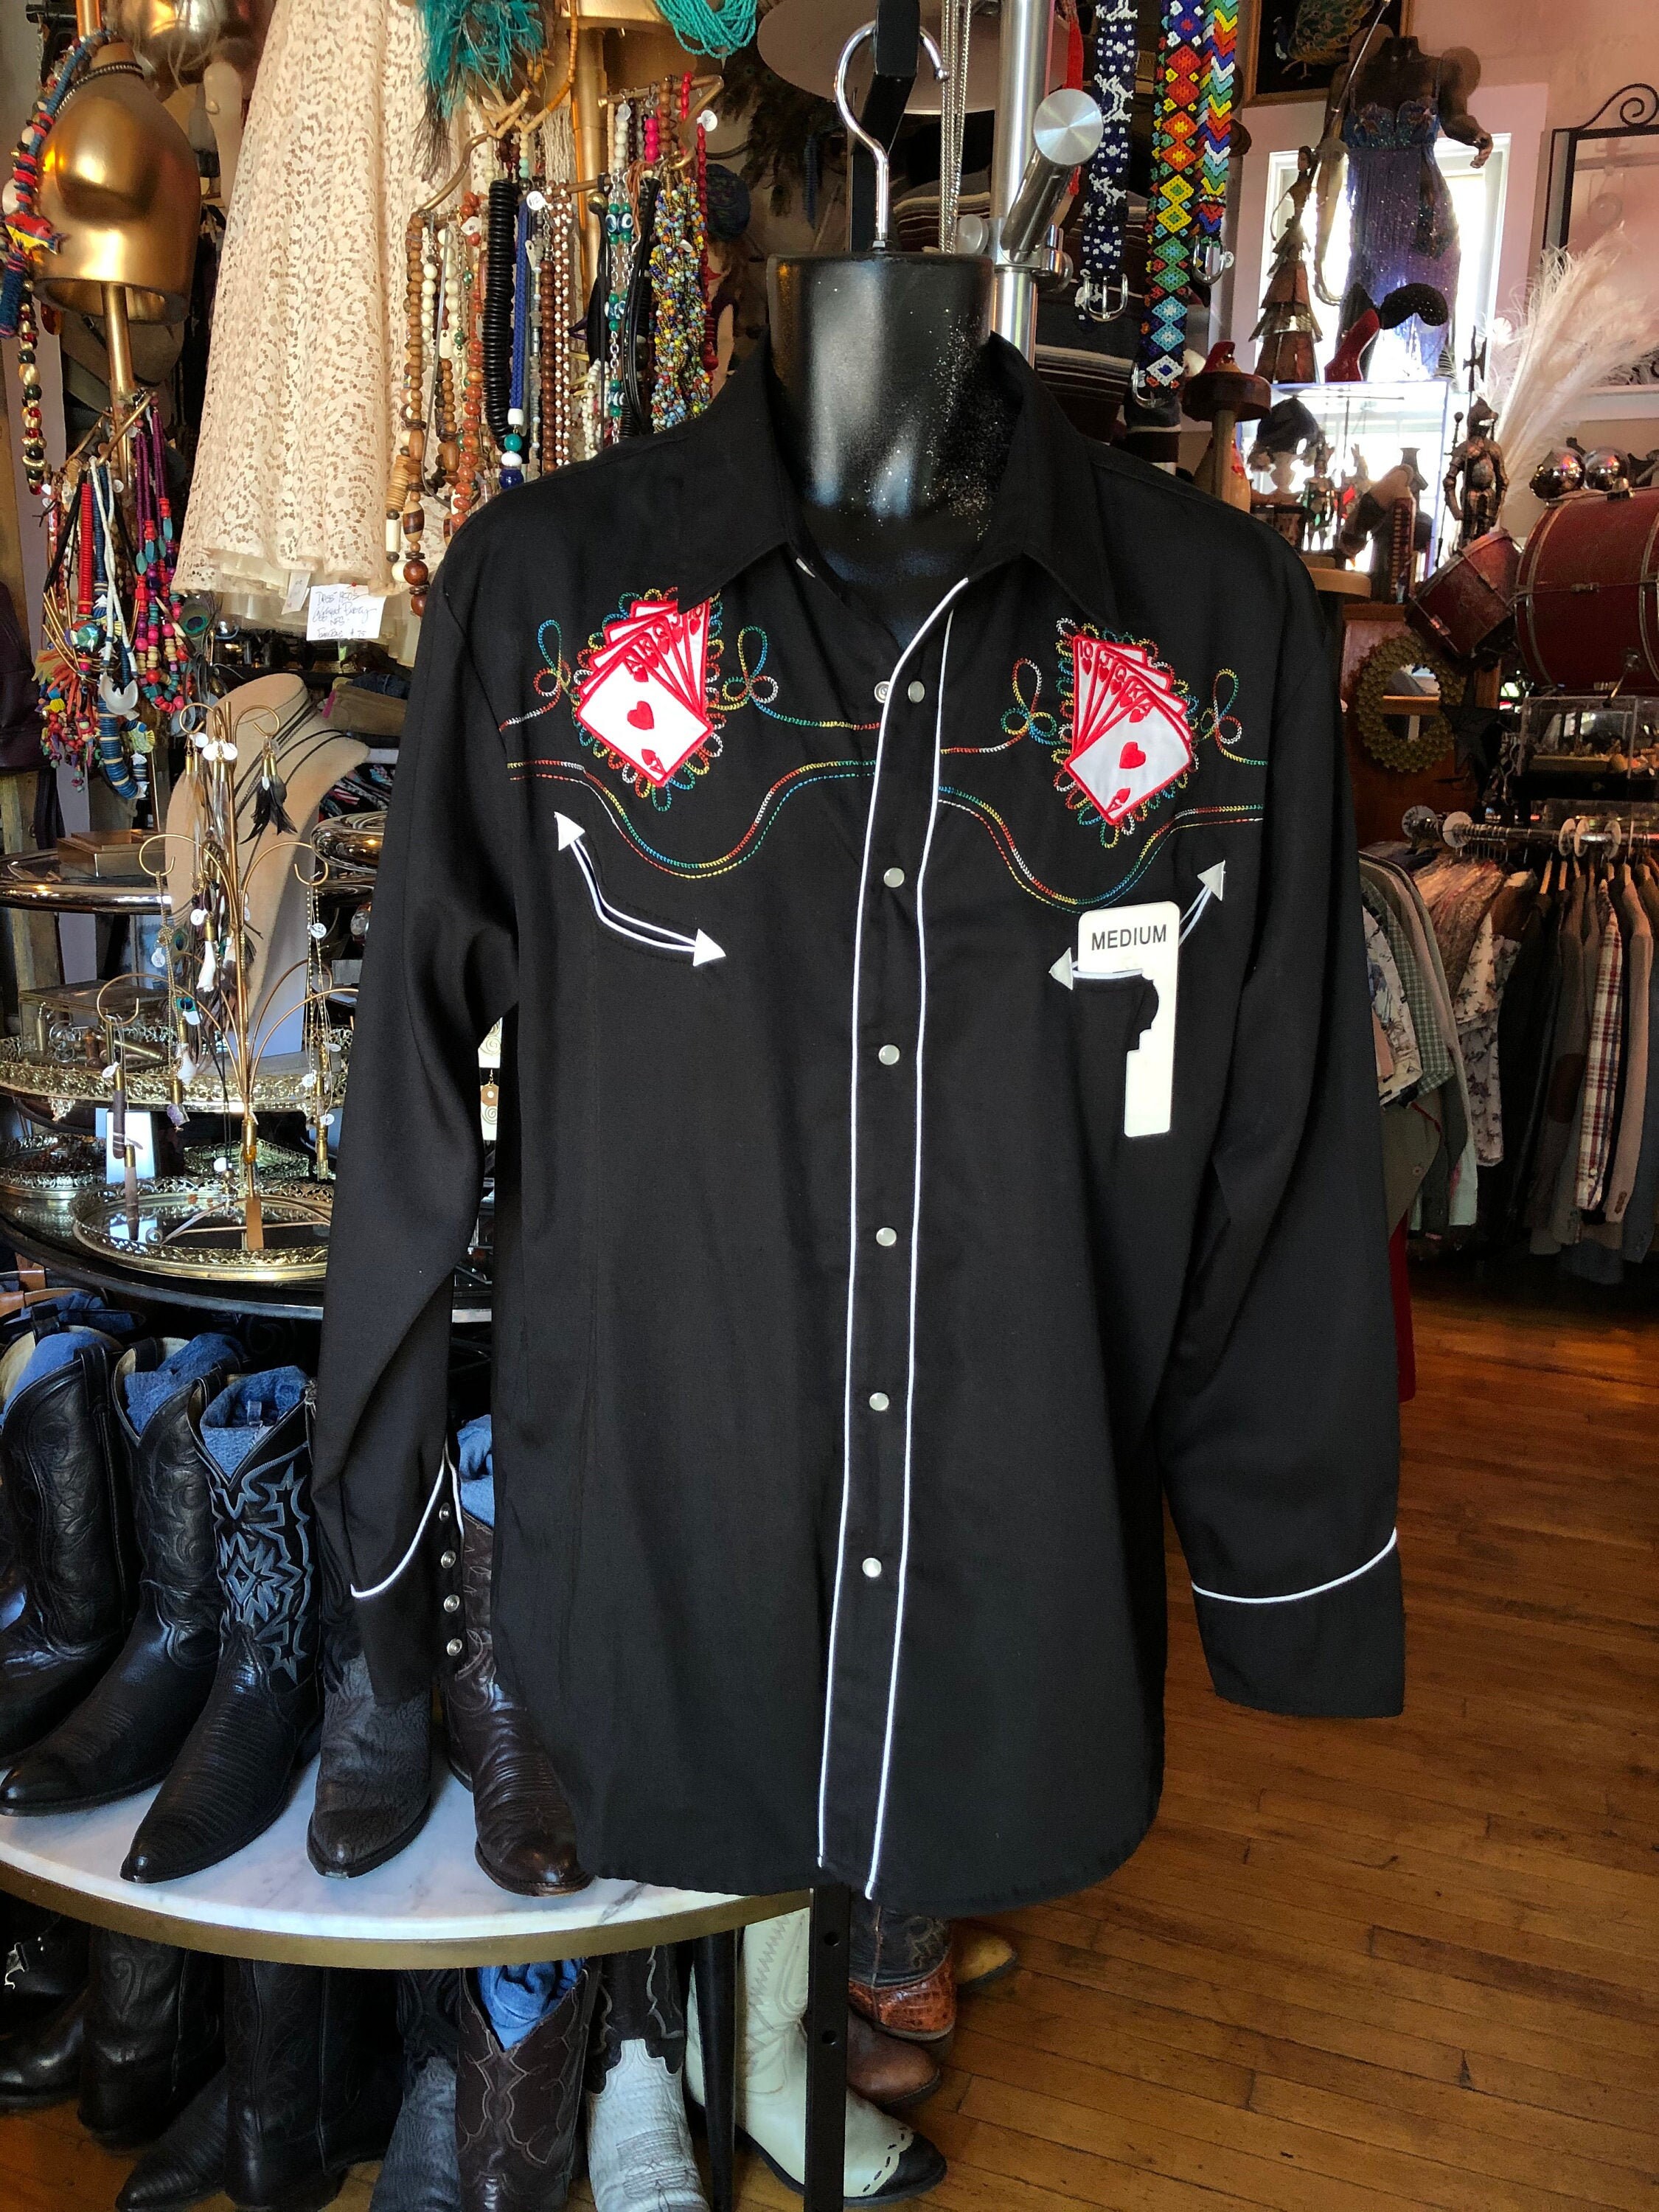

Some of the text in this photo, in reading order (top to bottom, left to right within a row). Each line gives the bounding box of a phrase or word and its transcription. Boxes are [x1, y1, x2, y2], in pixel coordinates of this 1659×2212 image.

[1079, 641, 1093, 658] 10
[1114, 665, 1127, 683] Q
[1091, 924, 1167, 951] MEDIUM
